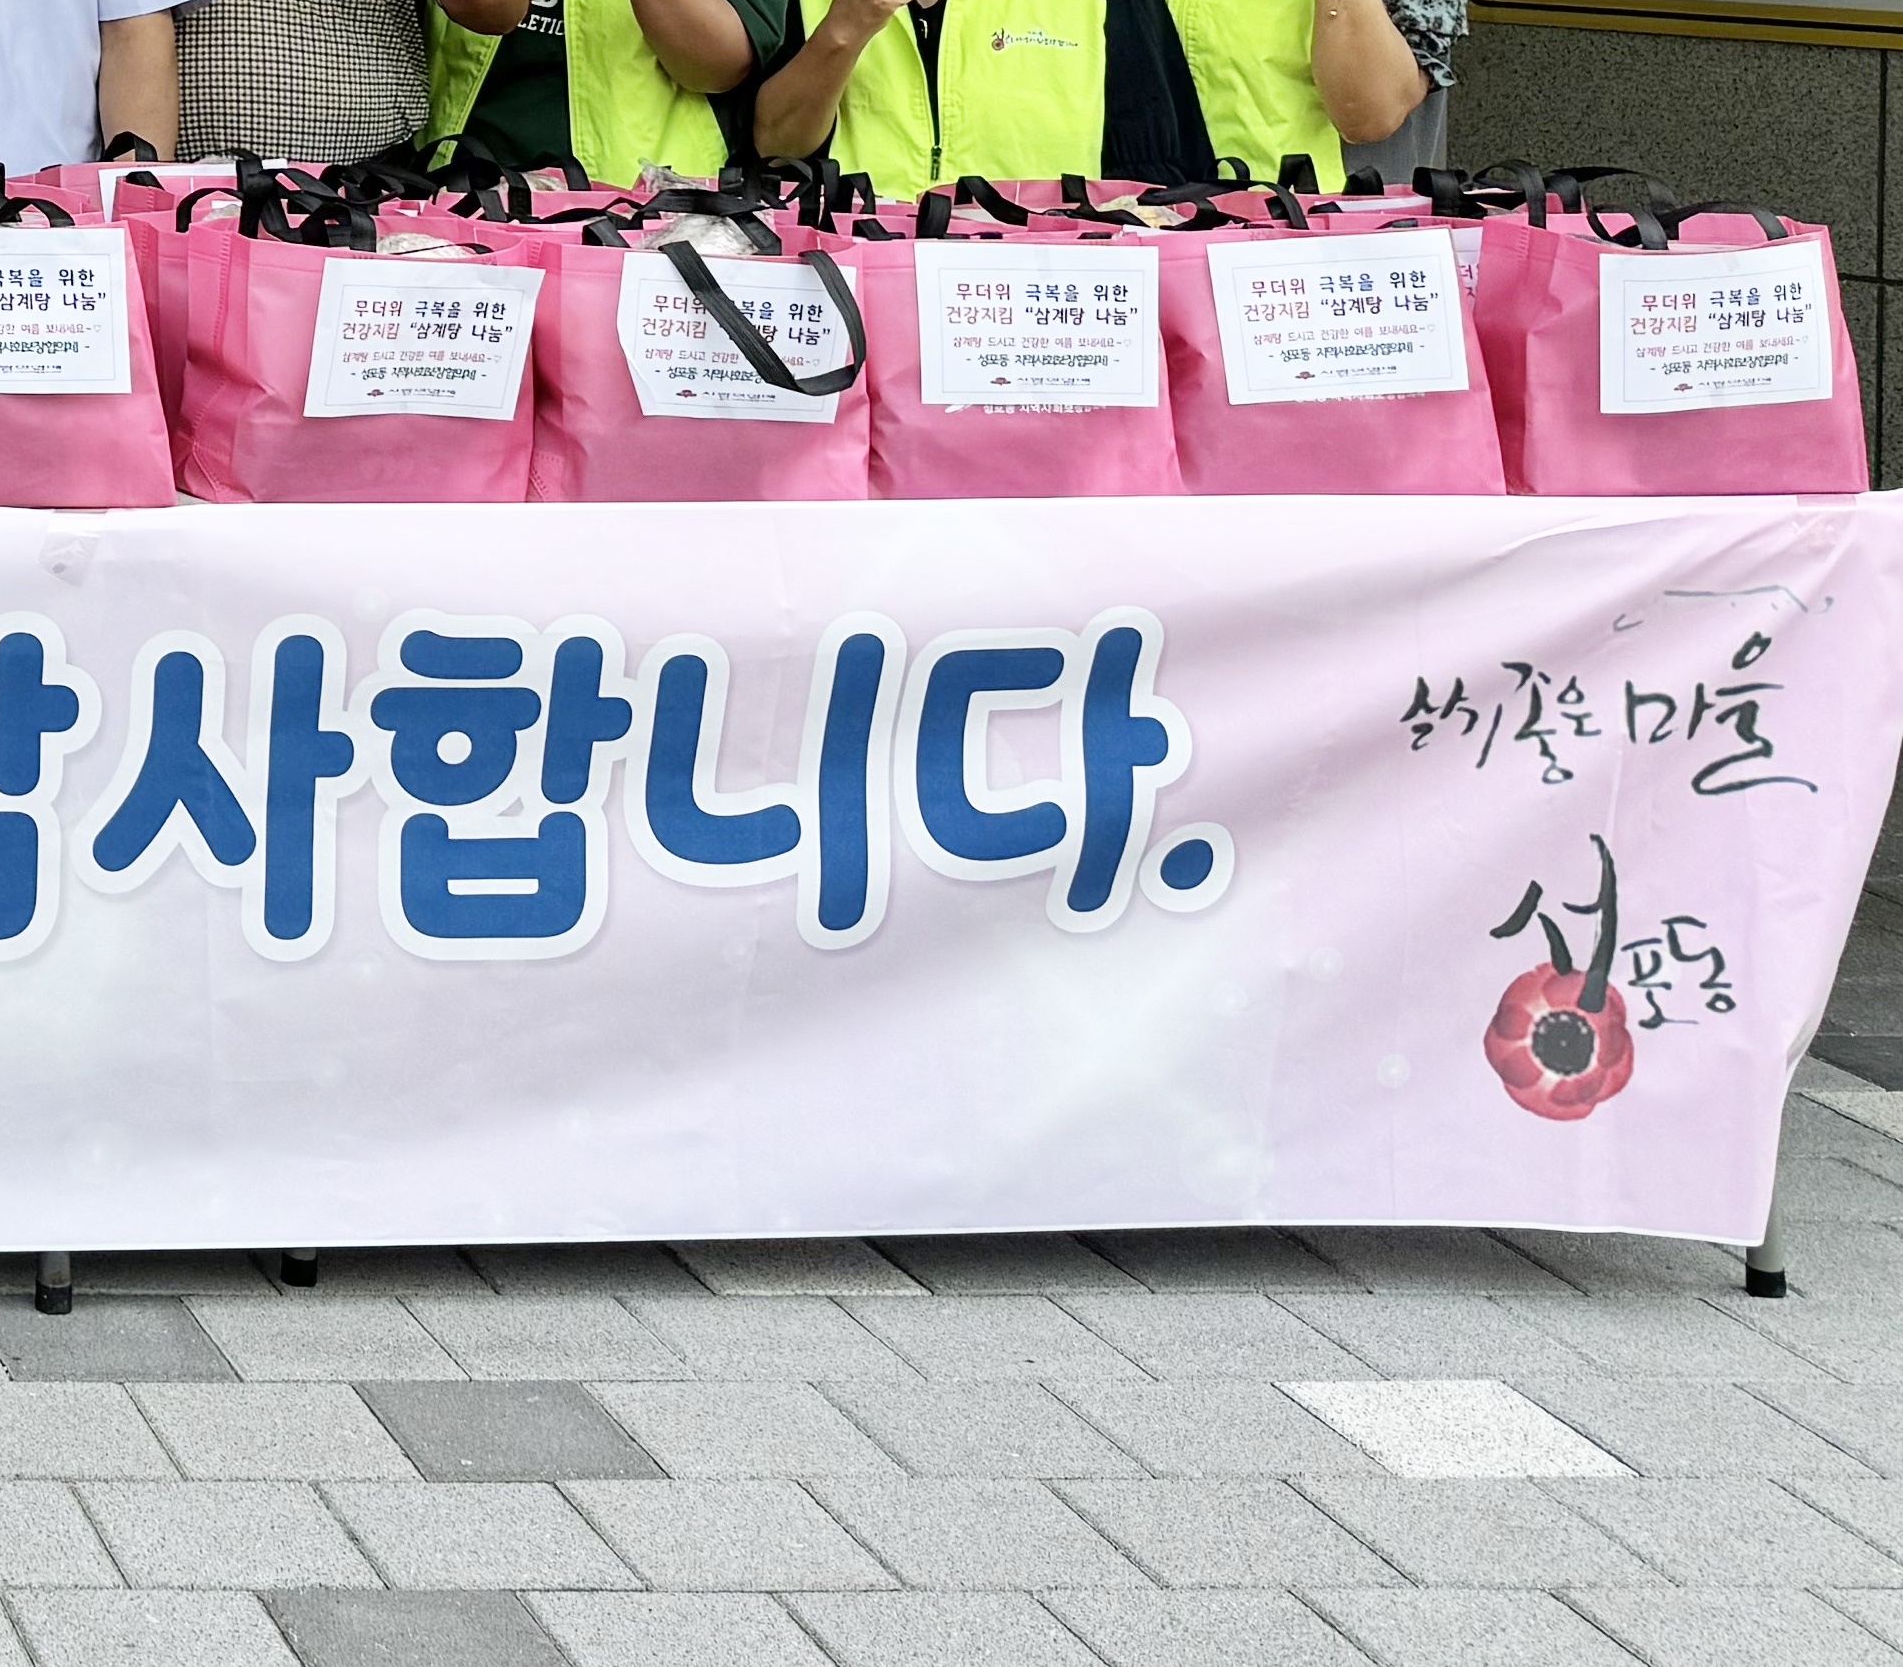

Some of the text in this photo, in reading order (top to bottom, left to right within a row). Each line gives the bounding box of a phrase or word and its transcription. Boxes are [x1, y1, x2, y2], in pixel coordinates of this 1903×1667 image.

[58, 269, 95, 287] 위한
[1251, 271, 1426, 298] 무더위 극복을 위한
[956, 284, 1128, 303] 무더위 극복을 위한
[1641, 283, 1802, 312] 무더위 극복을 위한
[354, 300, 506, 320] 무더위 극복을 위한
[740, 301, 774, 320] 복을
[788, 304, 823, 322] 위한
